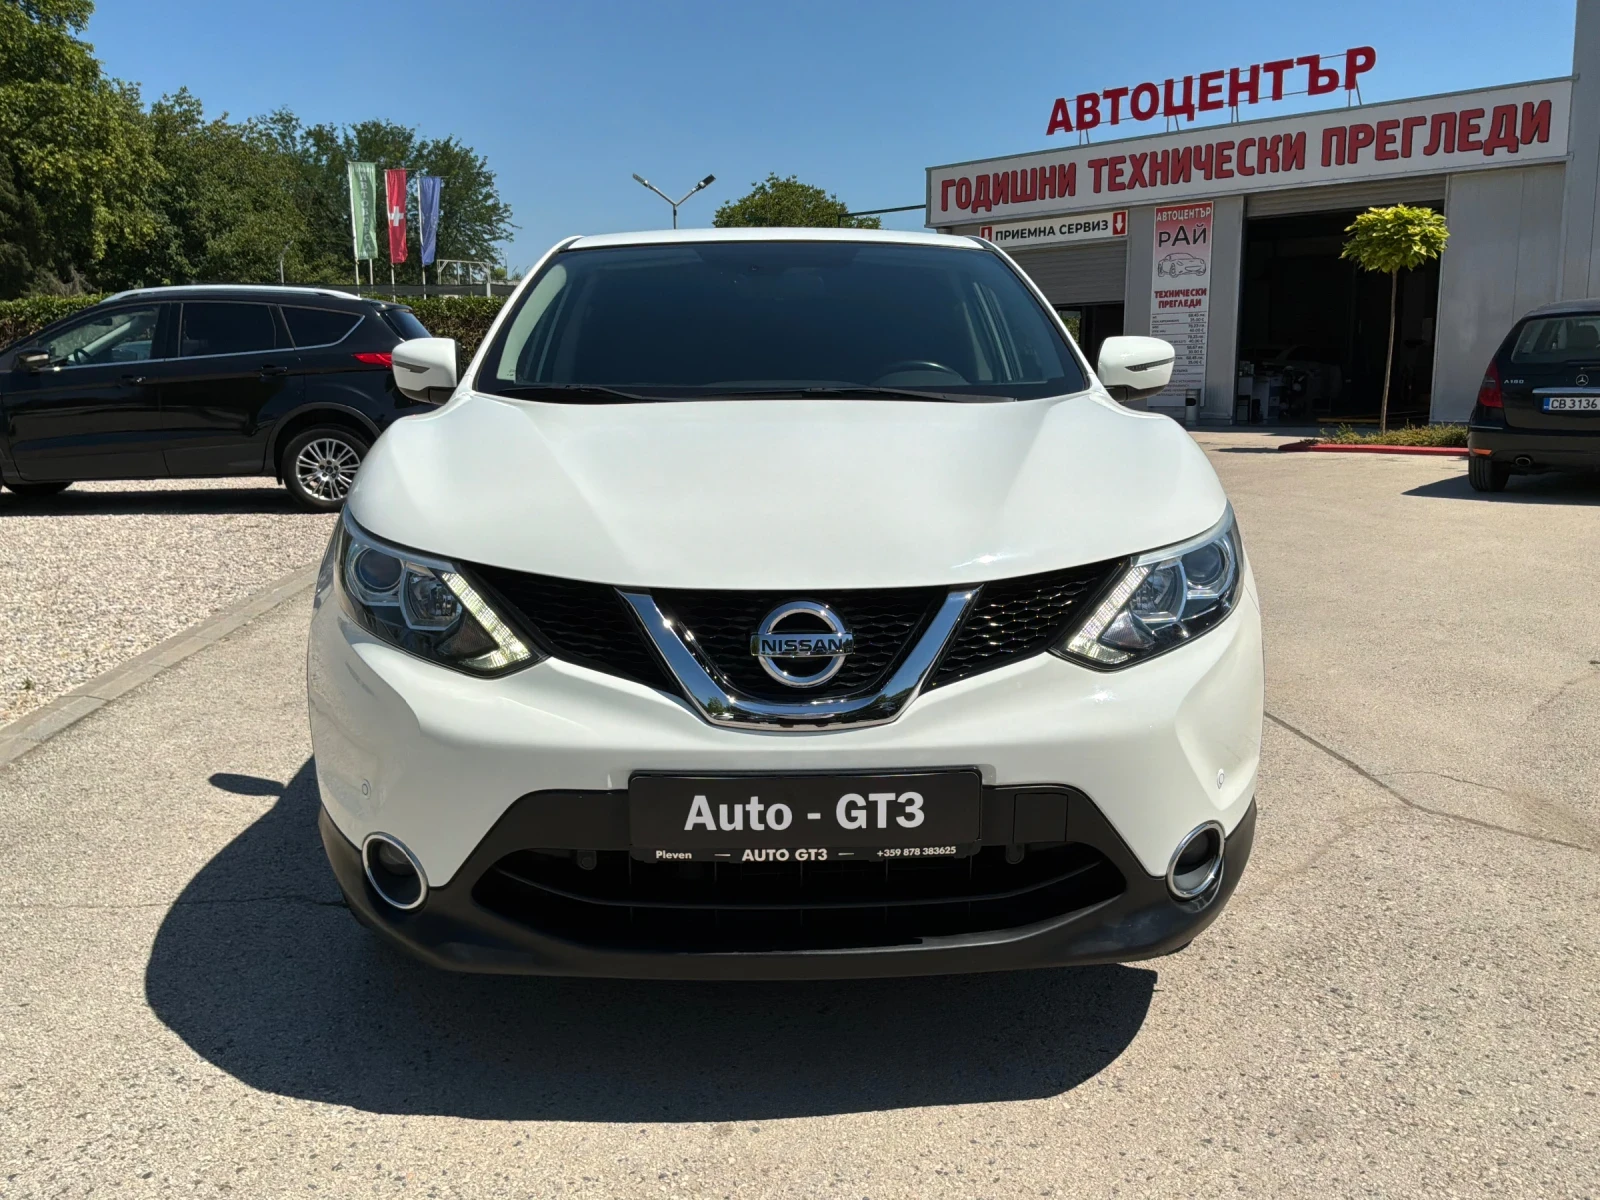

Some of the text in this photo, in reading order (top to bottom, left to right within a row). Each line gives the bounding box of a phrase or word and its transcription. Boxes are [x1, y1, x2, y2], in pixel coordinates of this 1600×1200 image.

[1047, 46, 1377, 135] АВТОЦЕНТЪР
[941, 100, 1552, 213] ГОДИШНИ ТЕХНИЧЕСКИ ПРЕГЛЕДИ
[1156, 206, 1212, 222] АВТОЦЕНТЪР
[995, 220, 1108, 241] ПРИЕМНА СЕРВИЗ
[1157, 222, 1207, 247] РАЙ
[1154, 288, 1207, 299] ТЕХНИЧЕСКИ
[1158, 298, 1202, 309] ПРЕГЛЕДИ
[1551, 399, 1598, 409] CB 3136
[761, 639, 843, 652] NISSAN
[684, 795, 793, 831] Auto
[835, 791, 926, 830] GT3
[655, 850, 692, 860] Pleven
[742, 849, 790, 861] AUTO
[795, 849, 828, 861] GT3
[877, 848, 901, 857] +359
[903, 847, 921, 857] 878
[922, 845, 957, 856] 383625
